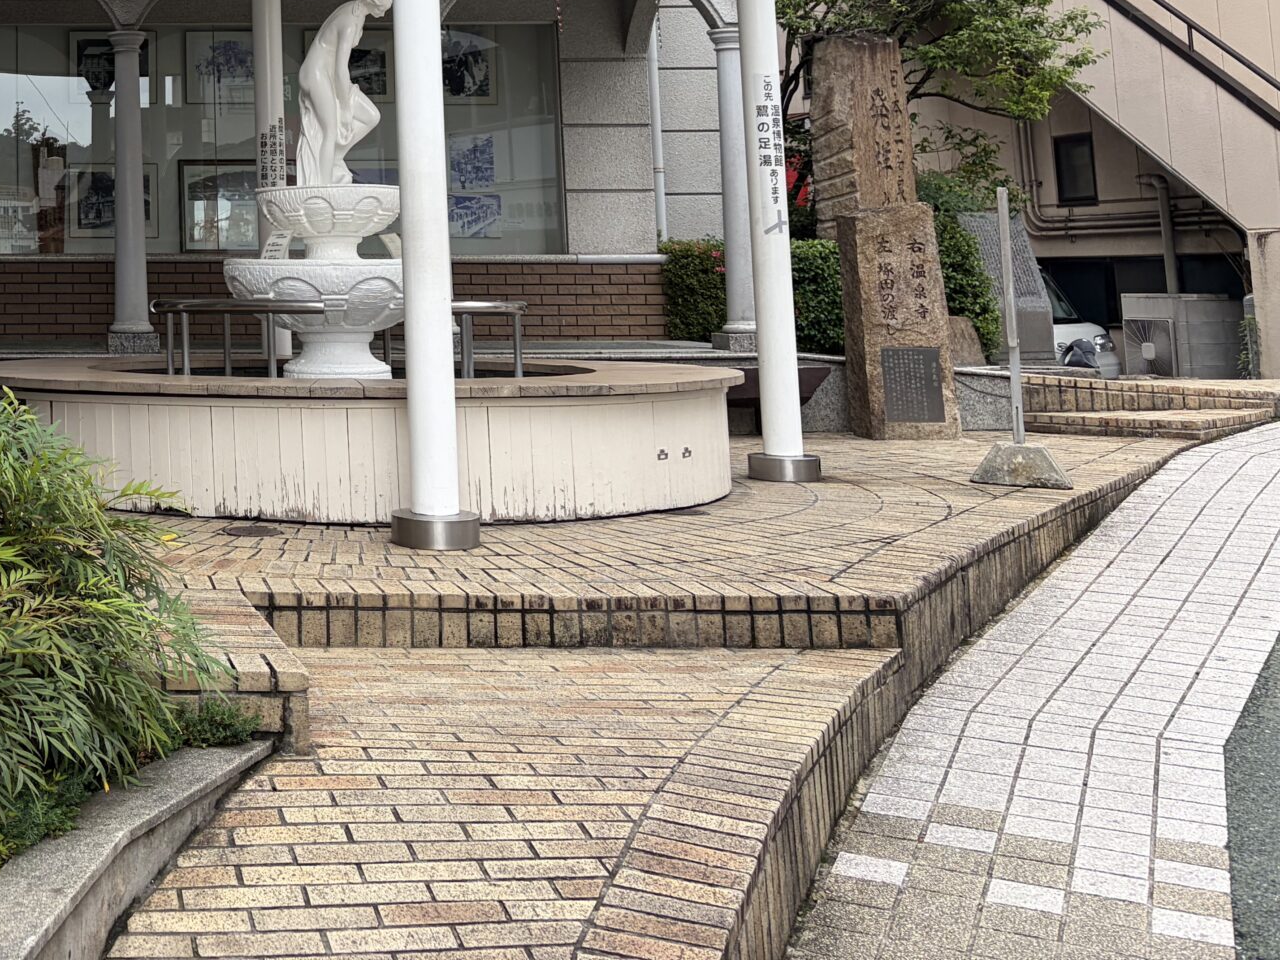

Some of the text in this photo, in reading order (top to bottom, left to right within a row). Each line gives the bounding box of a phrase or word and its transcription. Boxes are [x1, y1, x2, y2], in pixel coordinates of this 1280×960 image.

[763, 75, 774, 102] この先
[770, 104, 784, 167] 温泉博物館
[769, 169, 780, 205] あります
